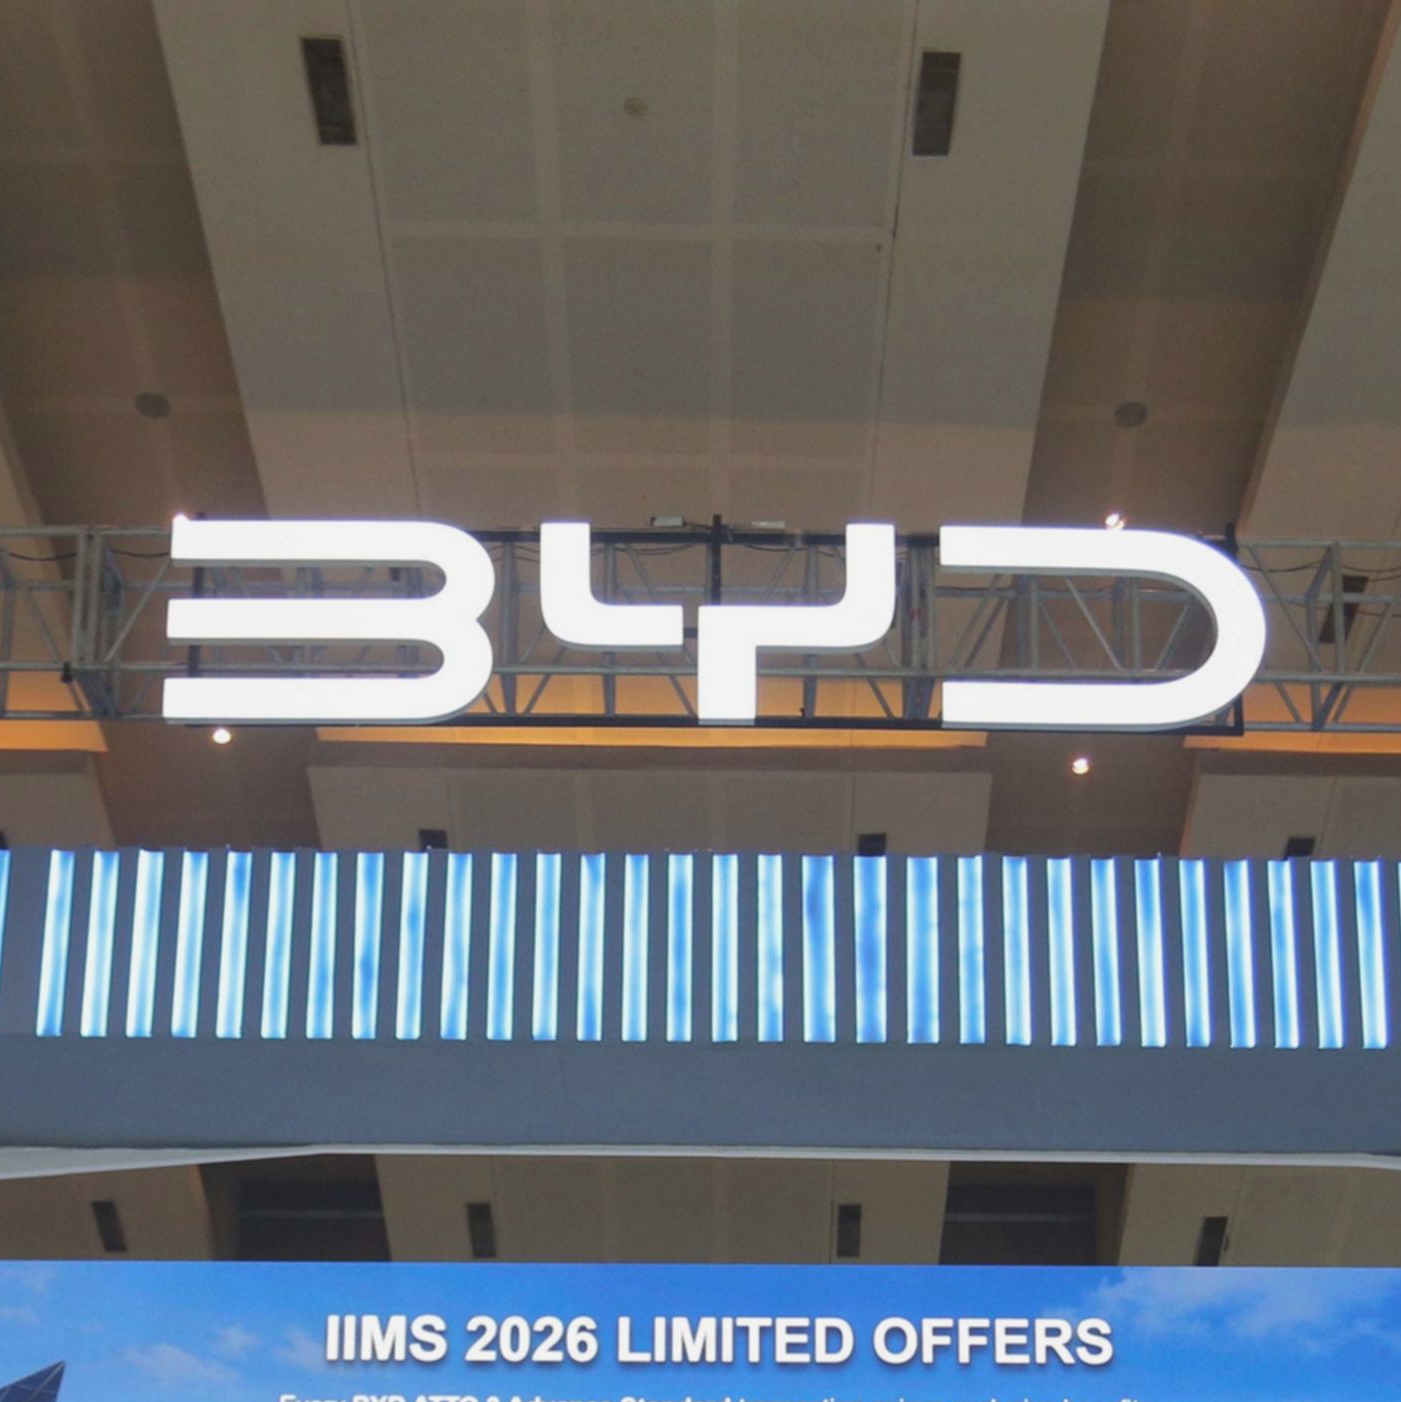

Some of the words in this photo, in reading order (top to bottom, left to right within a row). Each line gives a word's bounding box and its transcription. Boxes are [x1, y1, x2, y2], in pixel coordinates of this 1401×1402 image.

[162, 518, 1266, 728] BYD
[325, 1314, 448, 1362] IIMS
[464, 1314, 599, 1363] 2026
[616, 1315, 856, 1364] LIMITED
[872, 1316, 1115, 1366] OFFERS
